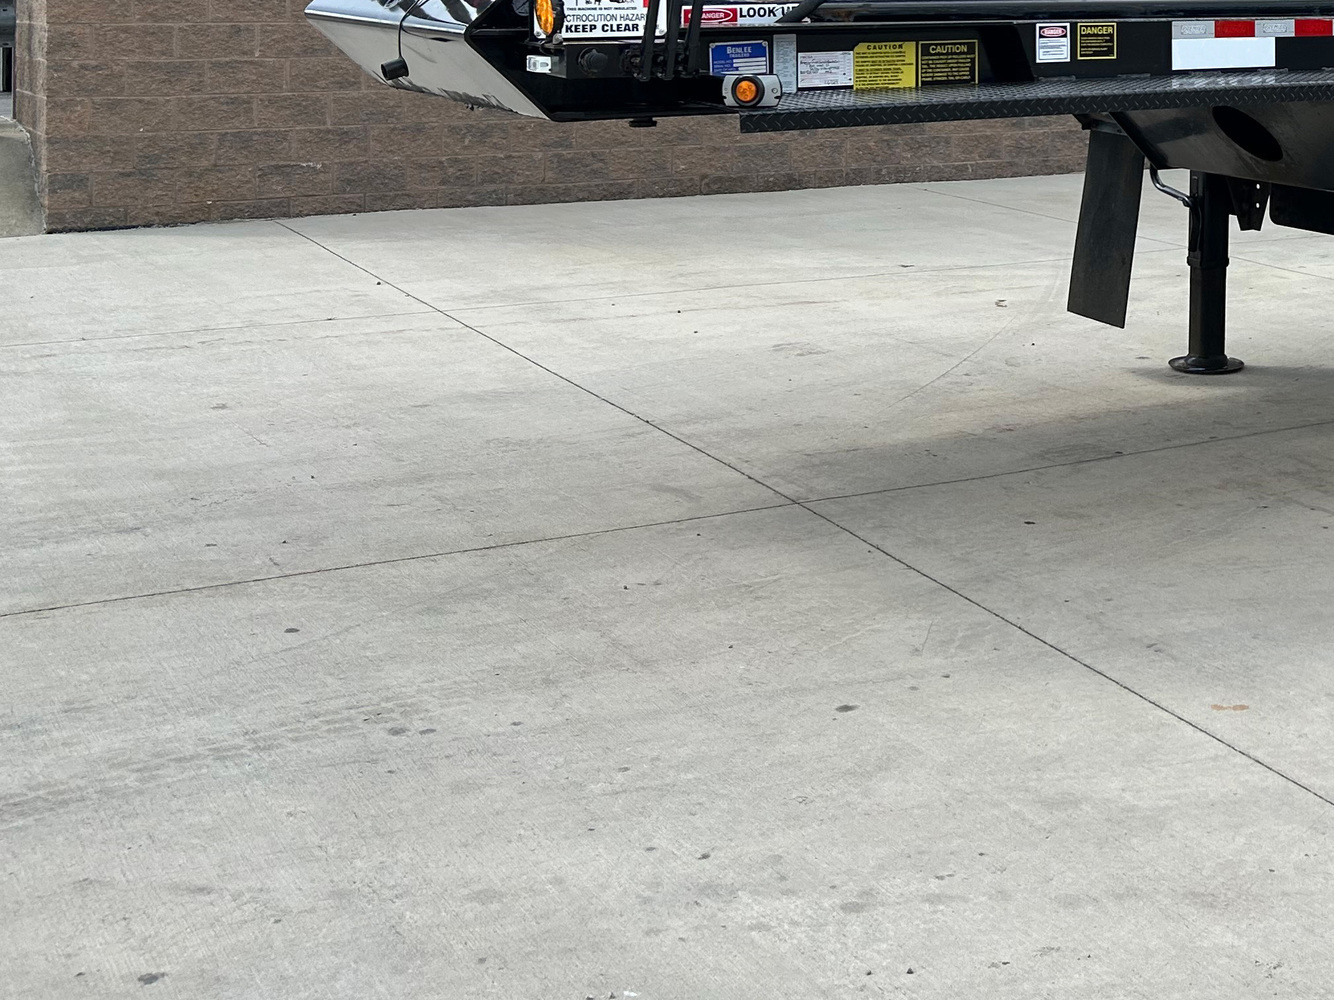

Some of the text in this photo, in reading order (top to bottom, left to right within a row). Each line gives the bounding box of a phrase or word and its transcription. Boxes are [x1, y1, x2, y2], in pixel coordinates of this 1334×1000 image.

[739, 6, 777, 18] LOOK
[565, 13, 647, 23] CTROCUTION HAZAR
[565, 24, 597, 33] KEEP
[601, 24, 639, 33] CLEAR
[1080, 26, 1114, 35] DANGER
[726, 46, 752, 54] BENLEE
[929, 45, 967, 53] CAUTION
